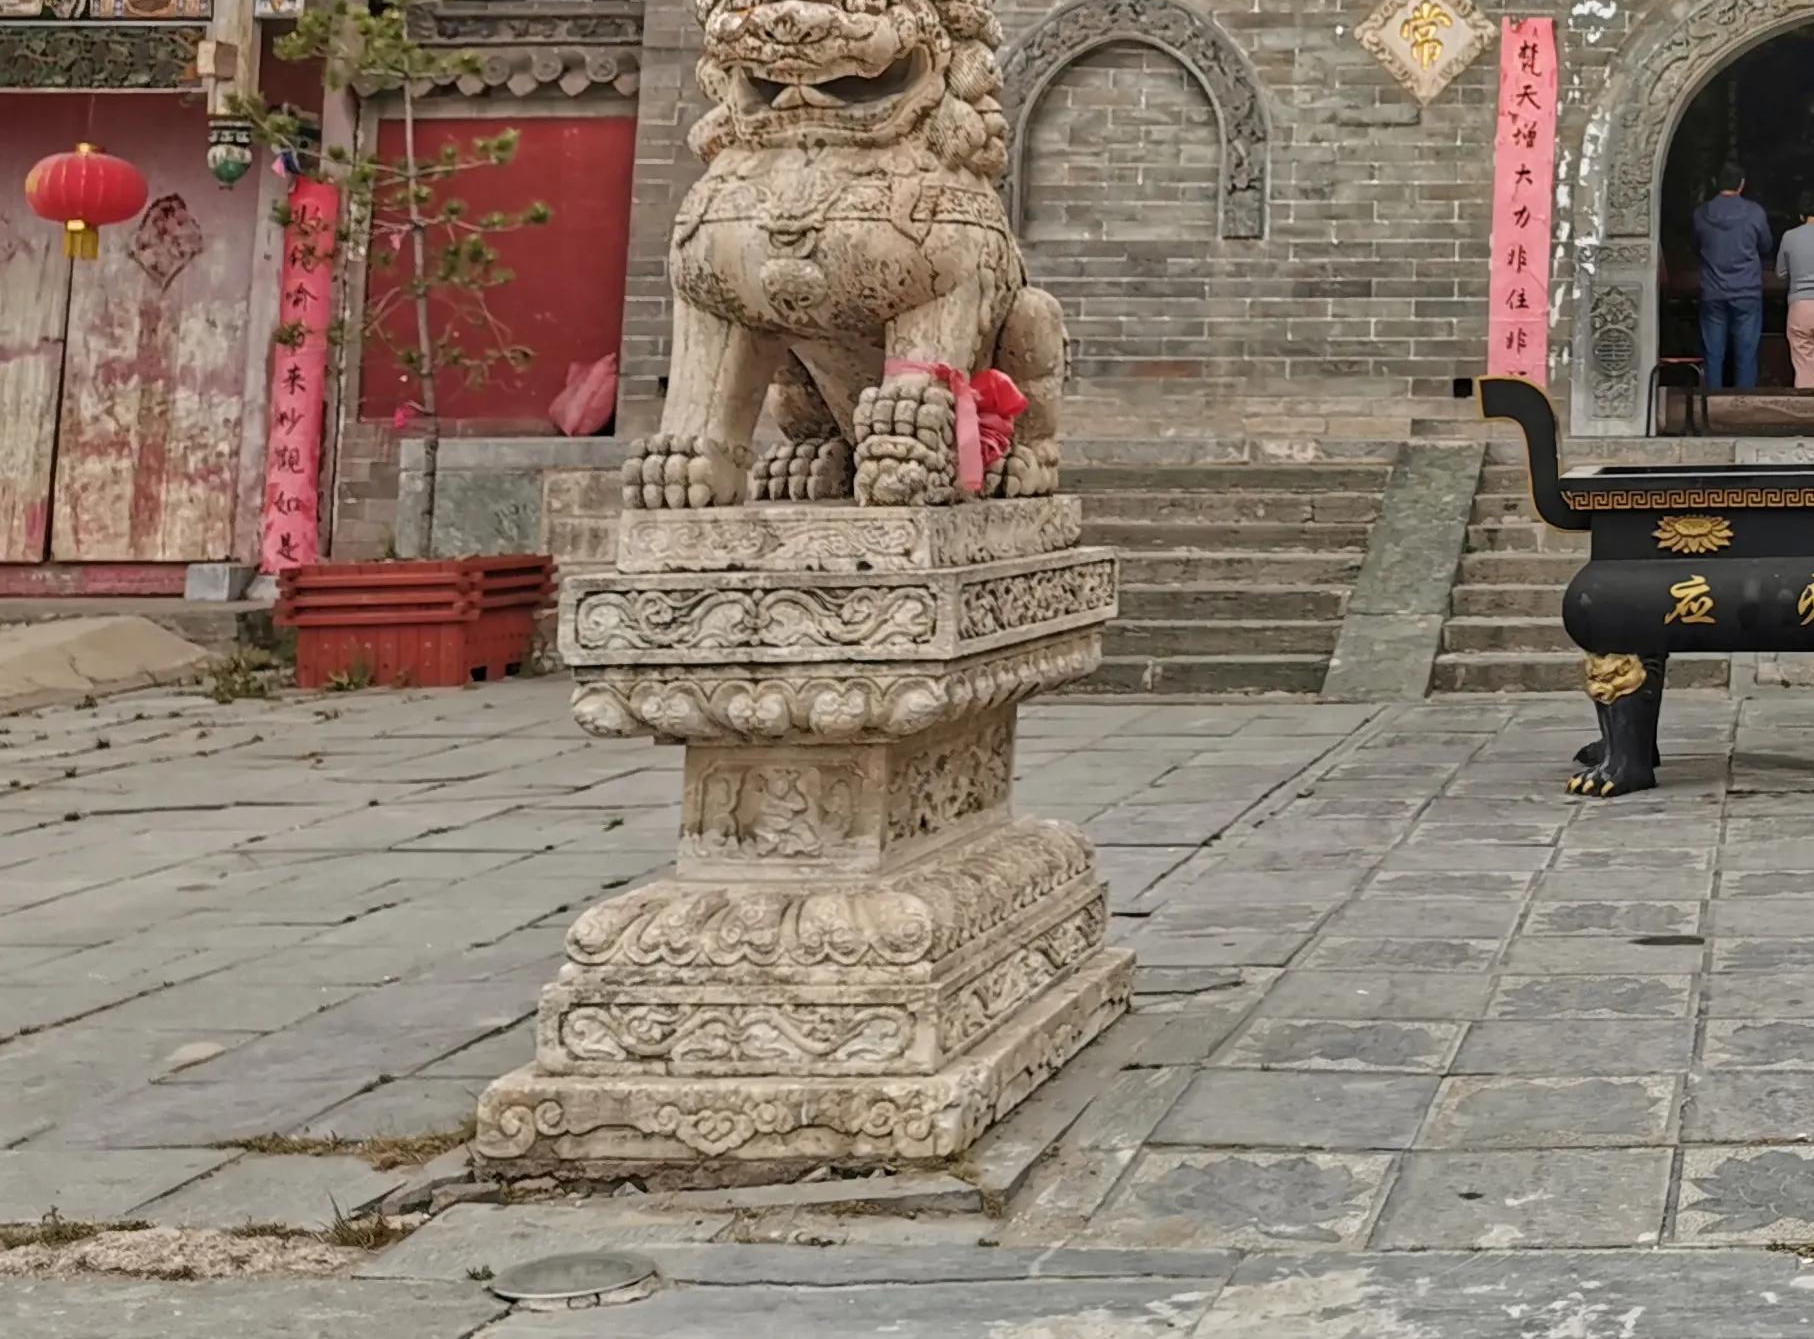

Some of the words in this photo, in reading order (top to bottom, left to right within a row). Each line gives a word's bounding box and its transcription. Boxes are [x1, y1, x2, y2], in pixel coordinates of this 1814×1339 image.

[1505, 39, 1543, 375] 梵天增大力非住非
